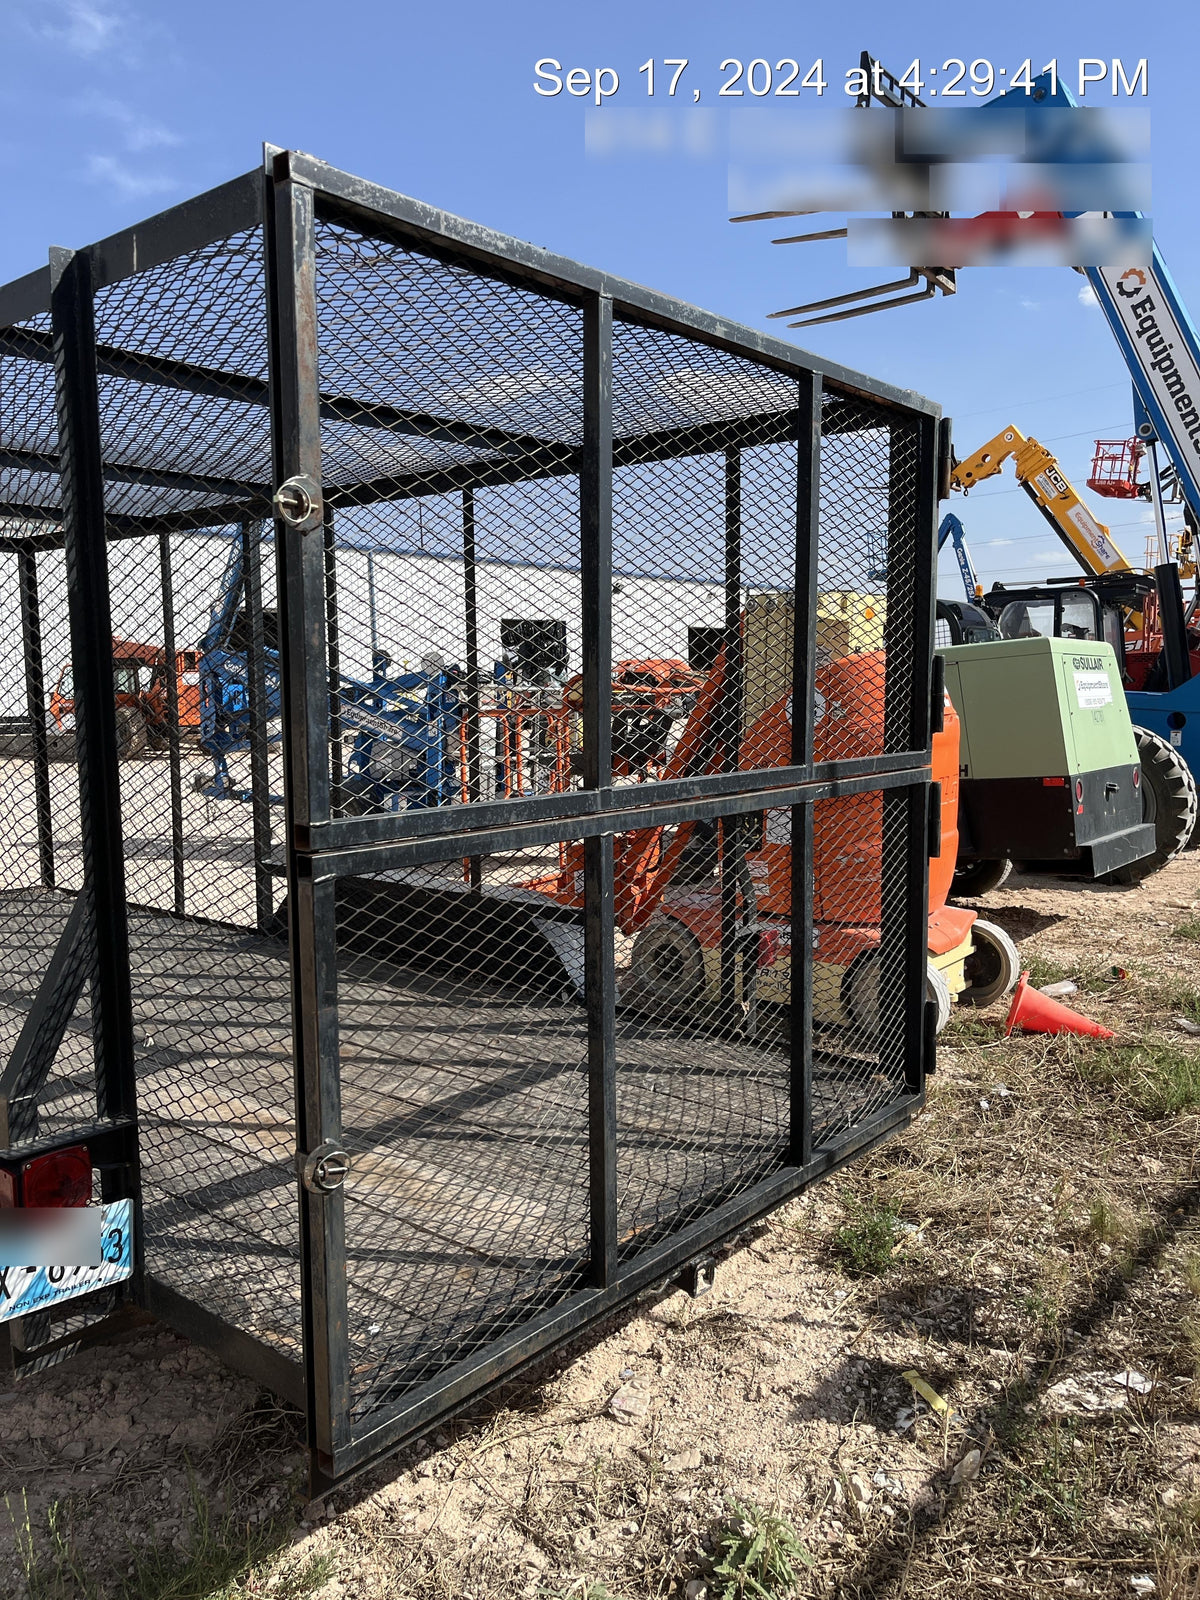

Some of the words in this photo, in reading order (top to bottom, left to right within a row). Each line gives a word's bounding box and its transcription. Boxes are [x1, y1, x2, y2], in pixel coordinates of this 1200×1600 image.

[1045, 468, 1067, 493] JCB
[1080, 657, 1104, 670] SULLAIR
[8, 1300, 30, 1312] NON
[32, 1293, 51, 1304] EXP
[54, 1279, 91, 1297] TRAILER
